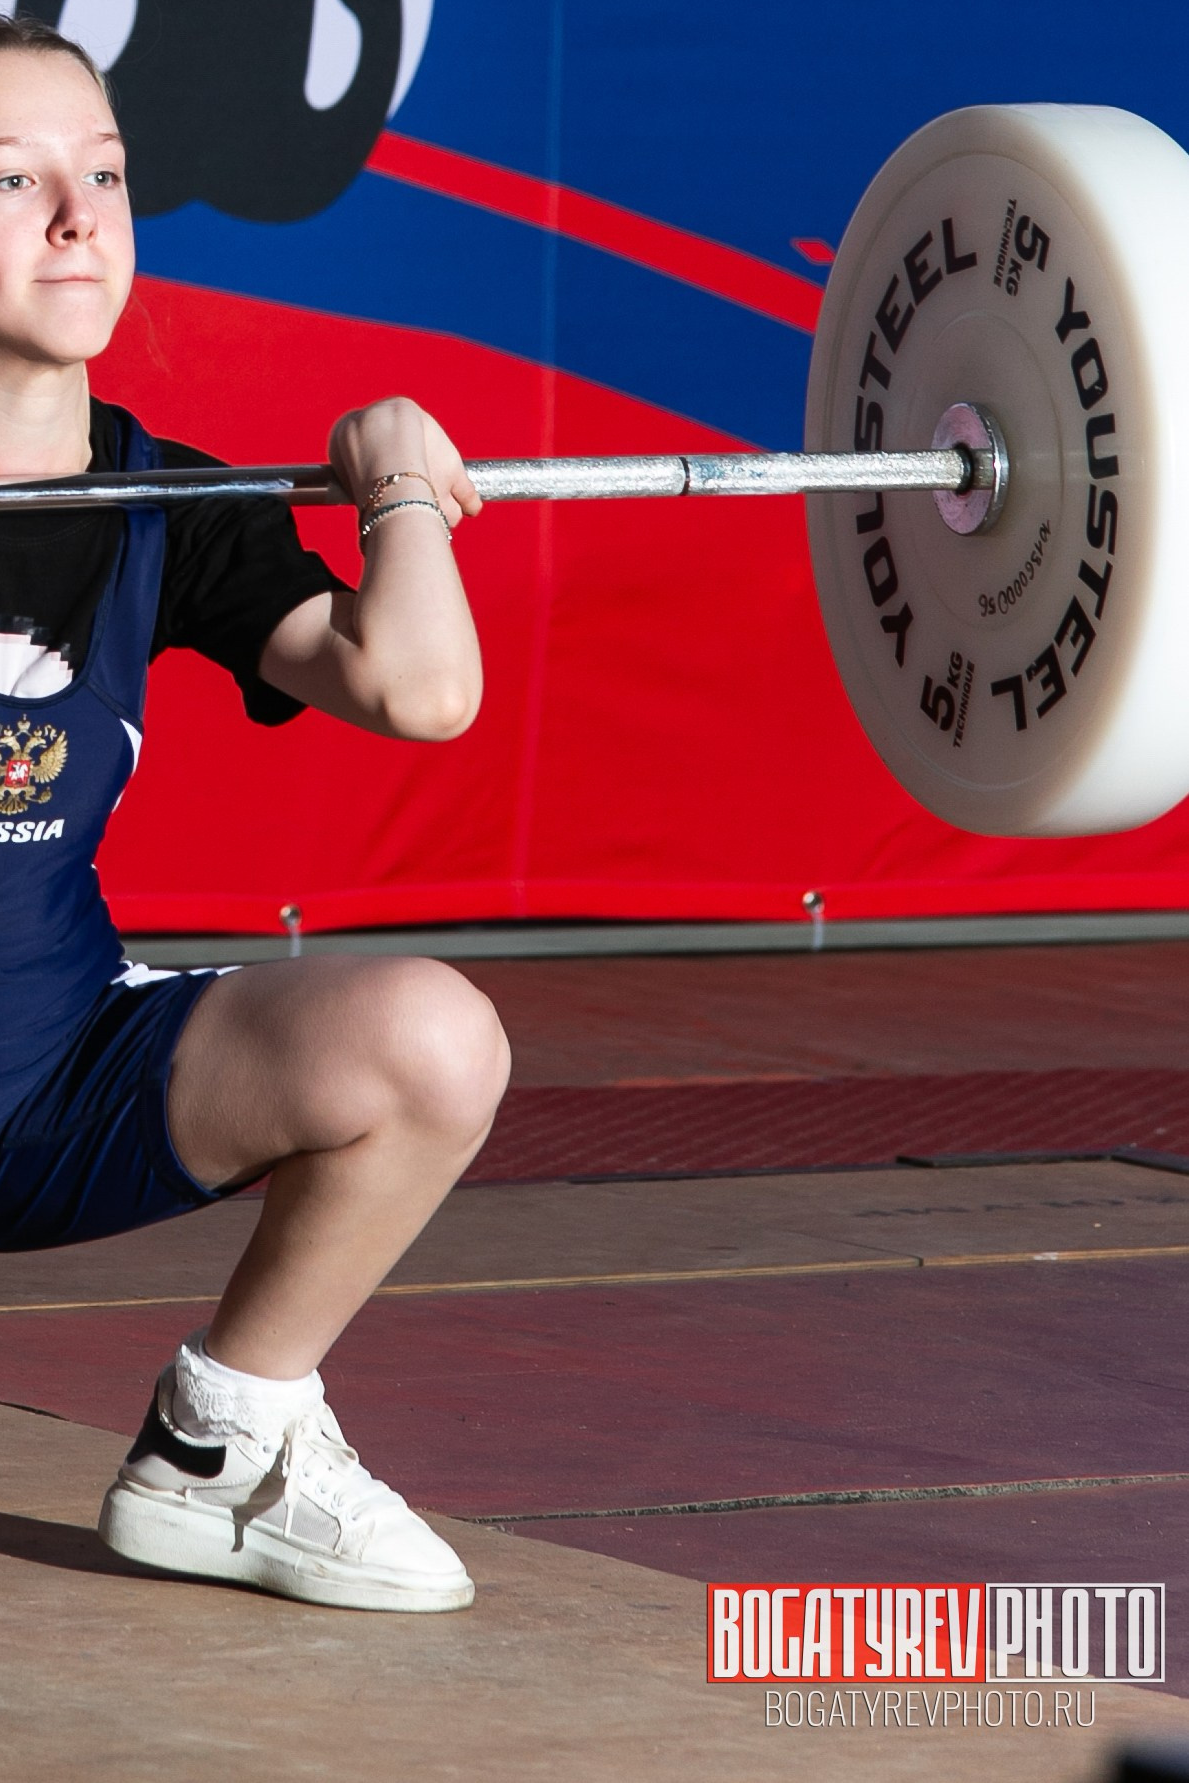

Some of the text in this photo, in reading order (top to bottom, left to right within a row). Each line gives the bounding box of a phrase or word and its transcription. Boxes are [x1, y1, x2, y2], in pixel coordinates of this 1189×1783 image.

[993, 199, 1017, 288] TECHNIQUE
[1005, 214, 1050, 297] 5 KG
[990, 276, 1120, 732] YOUSTEEL
[919, 651, 963, 732] 5 KG
[952, 660, 975, 748] TECHNIQUE
